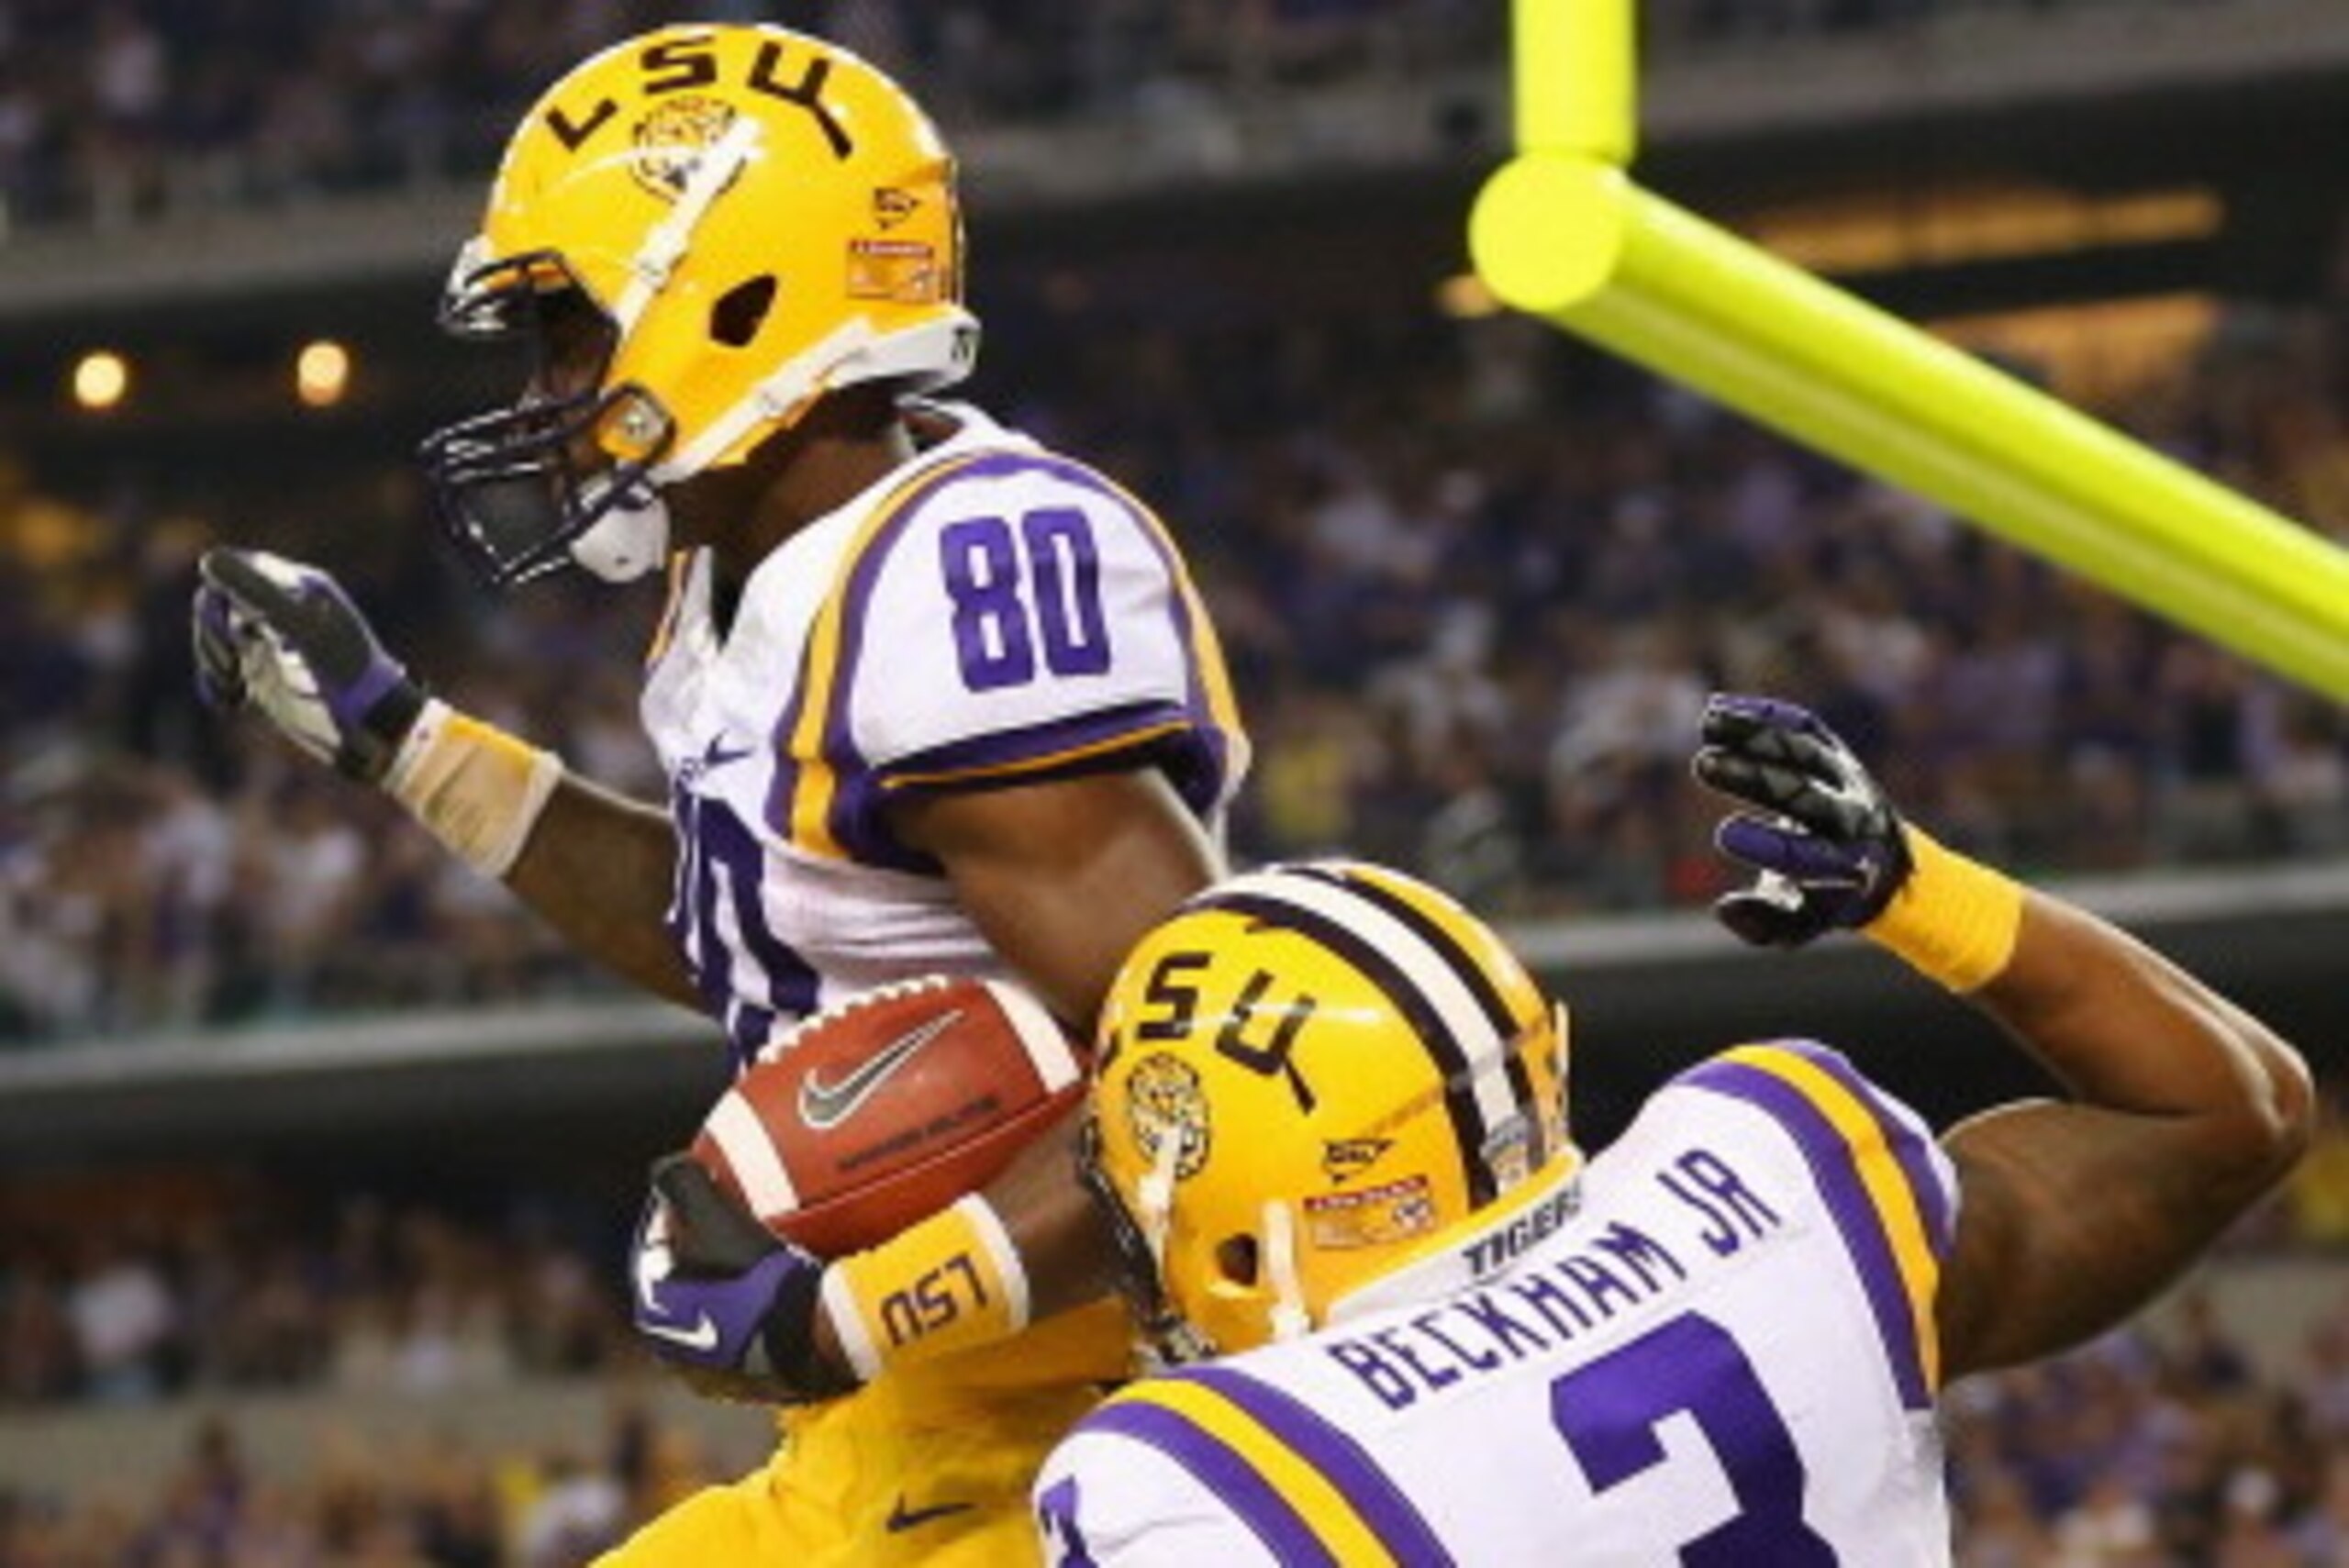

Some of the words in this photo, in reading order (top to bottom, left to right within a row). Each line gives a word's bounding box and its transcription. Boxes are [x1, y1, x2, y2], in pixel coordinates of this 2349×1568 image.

[545, 36, 852, 160] LSU
[939, 506, 1112, 695] 80
[880, 1251, 989, 1348] LSU
[1325, 1219, 1687, 1410] BECKHAM
[1655, 1148, 1781, 1258] JR
